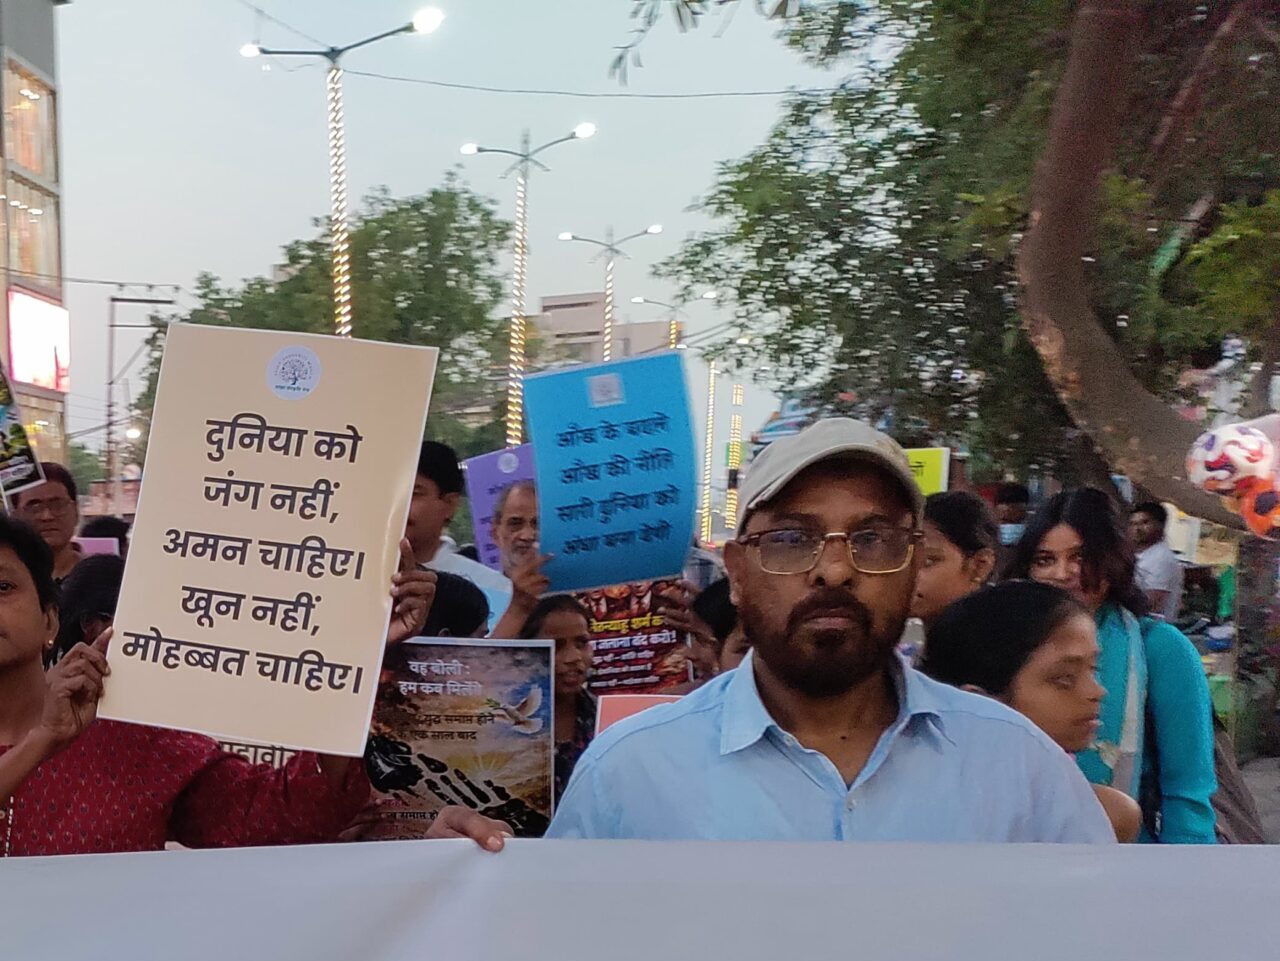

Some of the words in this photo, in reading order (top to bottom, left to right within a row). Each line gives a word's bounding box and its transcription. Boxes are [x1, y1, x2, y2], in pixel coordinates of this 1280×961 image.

[206, 412, 307, 463] दुनिया
[313, 425, 363, 464] को
[204, 470, 264, 511] जंग
[270, 479, 341, 524] नहीं,
[162, 529, 252, 566] अमन
[258, 536, 367, 580] चाहिए।
[180, 585, 247, 628] खून
[251, 592, 323, 635] नहीं,
[121, 627, 250, 677] मोहब्बत
[255, 650, 364, 694] चाहिए।
[407, 660, 428, 676] वह
[397, 681, 418, 695] हम
